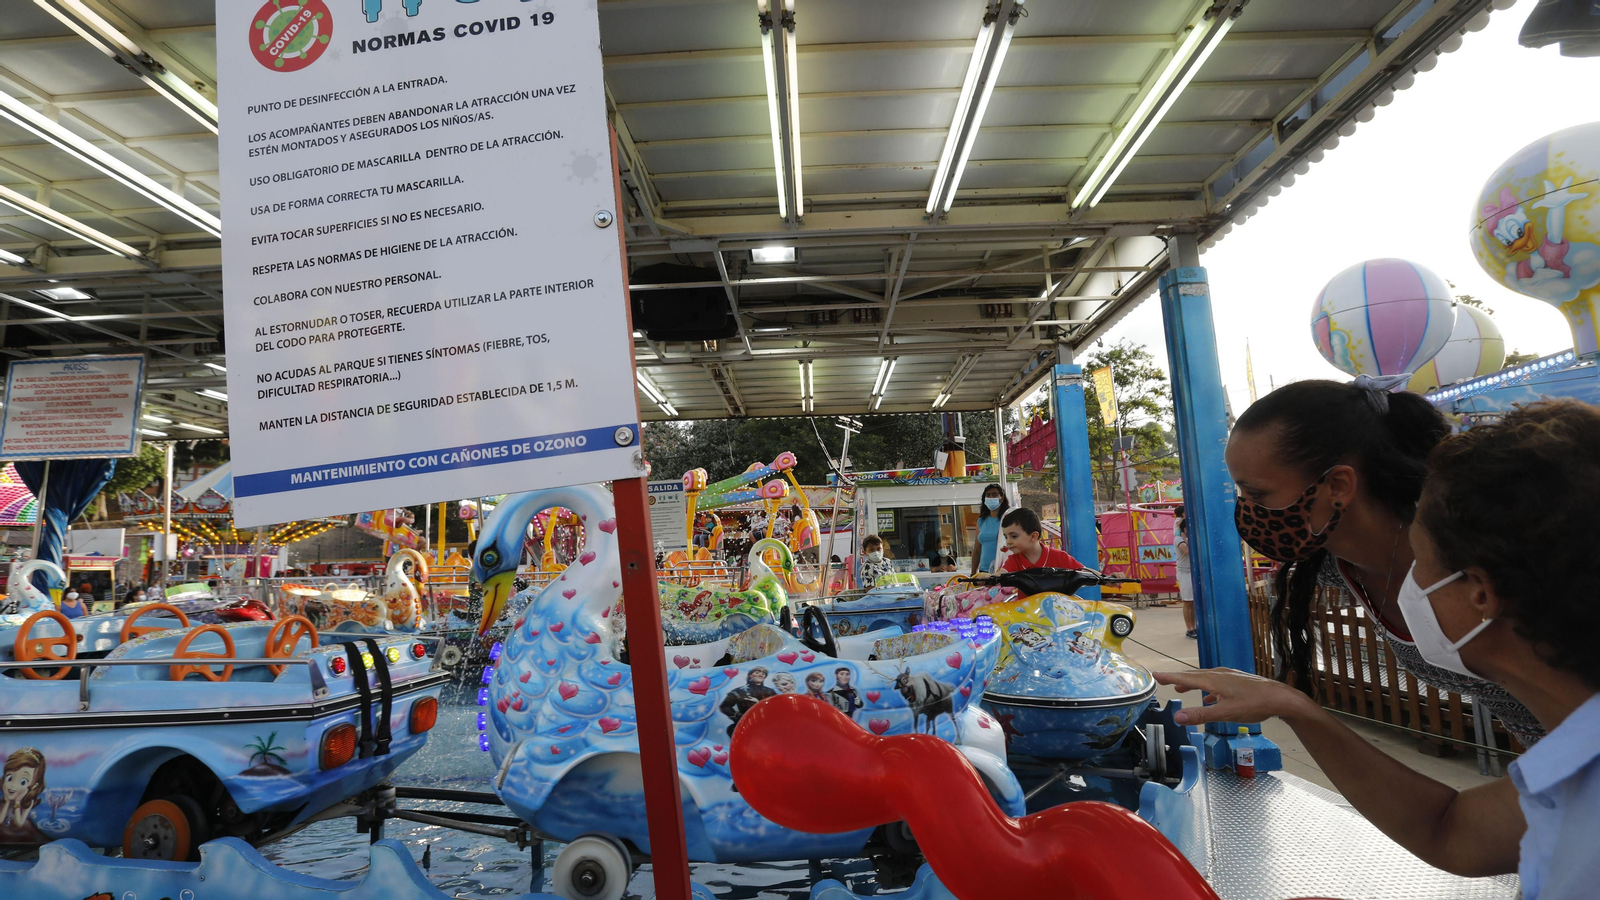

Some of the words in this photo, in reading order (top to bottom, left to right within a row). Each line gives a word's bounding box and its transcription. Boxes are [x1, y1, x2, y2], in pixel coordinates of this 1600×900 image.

[269, 9, 312, 56] COVID-19
[352, 27, 446, 54] NORMAS
[453, 16, 520, 38] COVID
[529, 11, 554, 26] 19
[247, 101, 282, 114] PUNTO
[283, 98, 297, 108] DE
[298, 87, 370, 106] DESINFECCIÓN
[372, 86, 380, 94] A
[382, 83, 395, 92] LA
[396, 75, 448, 90] ENTRADA.
[248, 132, 266, 143] LOS
[268, 118, 350, 139] ACOMPAÑANTES
[352, 113, 386, 126] DEBEN
[387, 102, 454, 120] ABANDONAR
[455, 100, 469, 110] LA
[470, 90, 529, 107] ATRACCIÓN
[531, 87, 554, 98] UNA
[555, 84, 576, 94] VEZ
[248, 144, 278, 157] ESTÉN
[280, 135, 338, 152] MONTADOS
[340, 134, 346, 142] Y
[348, 122, 418, 141] ASEGURADOS
[420, 119, 439, 130] LOS
[441, 111, 494, 126] NIÑOS/AS.
[249, 175, 270, 186] USO
[272, 164, 339, 182] OBLIGATORIO
[341, 161, 354, 172] DE
[356, 151, 421, 169] MASCARILLA
[425, 144, 468, 158] DENTRO
[469, 141, 484, 152] DE
[486, 139, 500, 149] LA
[501, 130, 564, 147] ATRACCIÓN.
[250, 205, 270, 215] USA
[272, 202, 286, 212] DE
[288, 196, 324, 210] FORMA
[326, 188, 378, 203] CORRECTA
[379, 185, 394, 195] TU
[396, 175, 464, 193] MASCARILLA.
[251, 233, 279, 245] EVITA
[279, 227, 314, 240] TOCAR
[316, 217, 378, 235] SUPERFICIES
[380, 216, 389, 225] SI
[391, 213, 408, 223] NO
[409, 210, 422, 221] ES
[423, 202, 484, 218] NECESARIO.
[252, 261, 294, 275] RESPETA
[296, 257, 315, 268] LAS
[317, 250, 362, 265] NORMAS
[364, 248, 378, 258] DE
[380, 241, 421, 256] HIGIENE
[423, 239, 437, 249] DE
[439, 237, 453, 247] LA
[455, 227, 517, 244] ATRACCIÓN.
[253, 289, 308, 306] COLABORA
[310, 286, 332, 297] CON
[334, 278, 382, 293] NUESTRO
[384, 270, 441, 286] PERSONAL.
[254, 327, 268, 336] AL
[269, 316, 338, 334] ESTORNUDAR
[339, 314, 348, 324] O
[348, 309, 384, 322] TOSER,
[386, 301, 442, 317] RECUERDA
[444, 293, 491, 308] UTILIZAR
[493, 291, 507, 301] LA
[509, 286, 542, 299] PARTE
[544, 278, 594, 294] INTERIOR
[255, 341, 275, 352] DEL
[276, 336, 306, 349] CODO
[308, 332, 335, 344] PARA
[337, 322, 405, 340] PROTEGERTE.
[256, 372, 272, 383] NO
[274, 366, 316, 381] ACUDAS
[318, 364, 332, 374] AL
[333, 358, 375, 372] PARQUE
[376, 356, 386, 366] SI
[387, 350, 423, 364] TIENES
[425, 342, 480, 359] SÍNTOMAS
[482, 336, 524, 352] (FIEBRE,
[525, 333, 550, 344] TOS,
[257, 382, 315, 399] DIFICULTAD
[317, 370, 401, 390] RESPIRATORIA...)
[259, 416, 302, 431] MANTEN
[304, 414, 318, 424] LA
[320, 406, 374, 422] DISTANCIA
[376, 403, 391, 414] DE
[392, 395, 454, 412] SEGURIDAD
[456, 385, 527, 403] ESTABLECIDA
[529, 382, 544, 393] DE
[546, 380, 562, 391] 1,5
[565, 378, 578, 388] M.
[290, 459, 405, 484] MANTENIMIENTO
[408, 454, 438, 468] CON
[440, 445, 509, 464] CAÑONES
[511, 442, 531, 455] DE
[533, 435, 587, 452] OZONO
[648, 484, 679, 492] SALIDA
